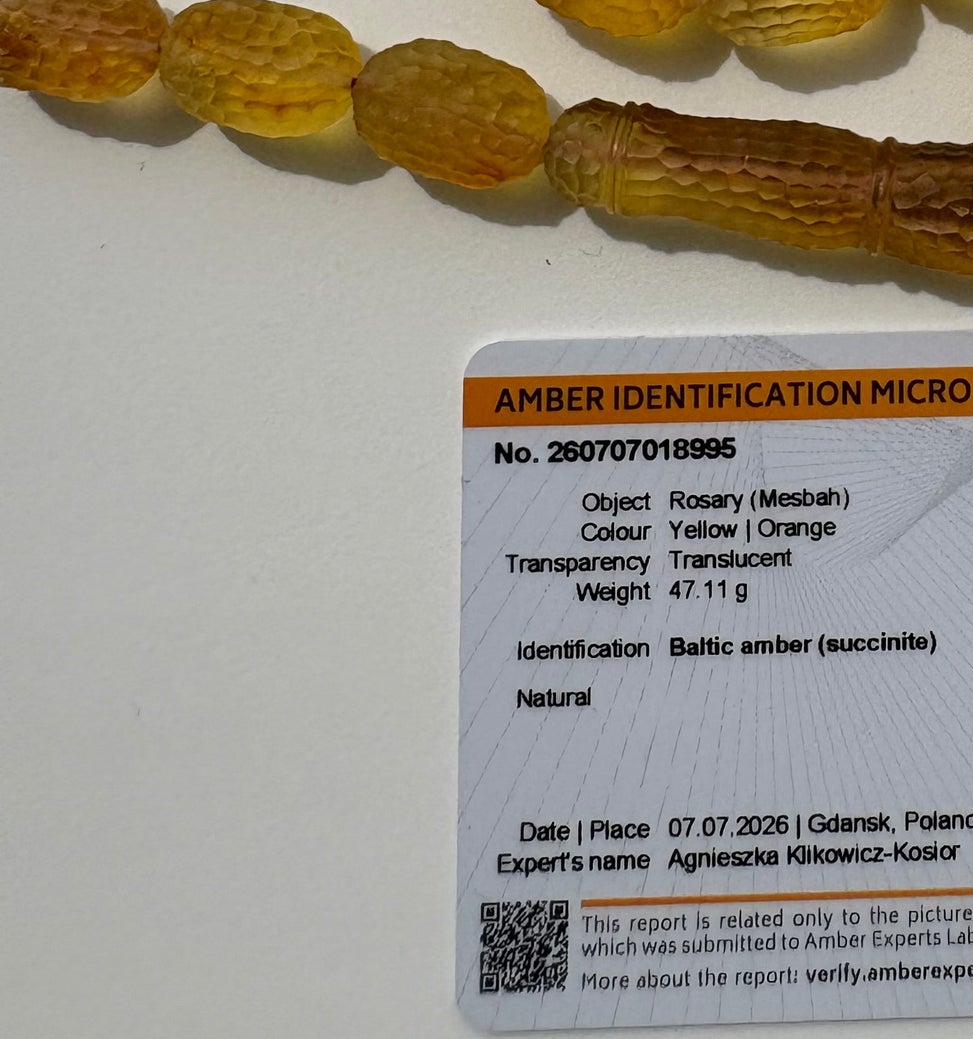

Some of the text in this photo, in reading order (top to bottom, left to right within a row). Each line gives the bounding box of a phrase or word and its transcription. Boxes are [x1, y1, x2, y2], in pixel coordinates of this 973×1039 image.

[495, 386, 604, 413] AMBER
[613, 382, 862, 411] IDENTIFICATION
[871, 379, 971, 405] MICRO
[494, 437, 736, 465] No. 260707018995
[582, 487, 850, 515] Object Rosary (Mesbah)
[581, 520, 651, 542] Colour
[669, 519, 737, 540] Yellow
[757, 518, 836, 541] Orange
[506, 549, 792, 577] Transparency Translucent
[576, 580, 748, 605] Weight 47.11 g
[517, 631, 937, 660] Identification Baltic amber (succinite)
[517, 688, 591, 708] Natural
[520, 821, 570, 842] Date
[590, 819, 650, 841] Place
[667, 815, 789, 838] 07.07.2026
[807, 812, 897, 836] Gdansk,
[497, 842, 960, 874] Expert's name Agnieszka Klikowicz-Kosior
[581, 913, 620, 932] This
[629, 912, 688, 935] report
[695, 910, 712, 930] is
[719, 908, 784, 929] related
[793, 908, 834, 932] only
[842, 908, 862, 926] to
[870, 906, 899, 925] the
[581, 938, 637, 958] which
[642, 940, 677, 954] was
[682, 932, 777, 954] submitted
[781, 934, 800, 952] to
[805, 930, 866, 950] Amber
[872, 929, 941, 952] Experts
[581, 972, 629, 992] More
[636, 969, 691, 989] about
[698, 969, 728, 988] the
[735, 966, 799, 990] report:
